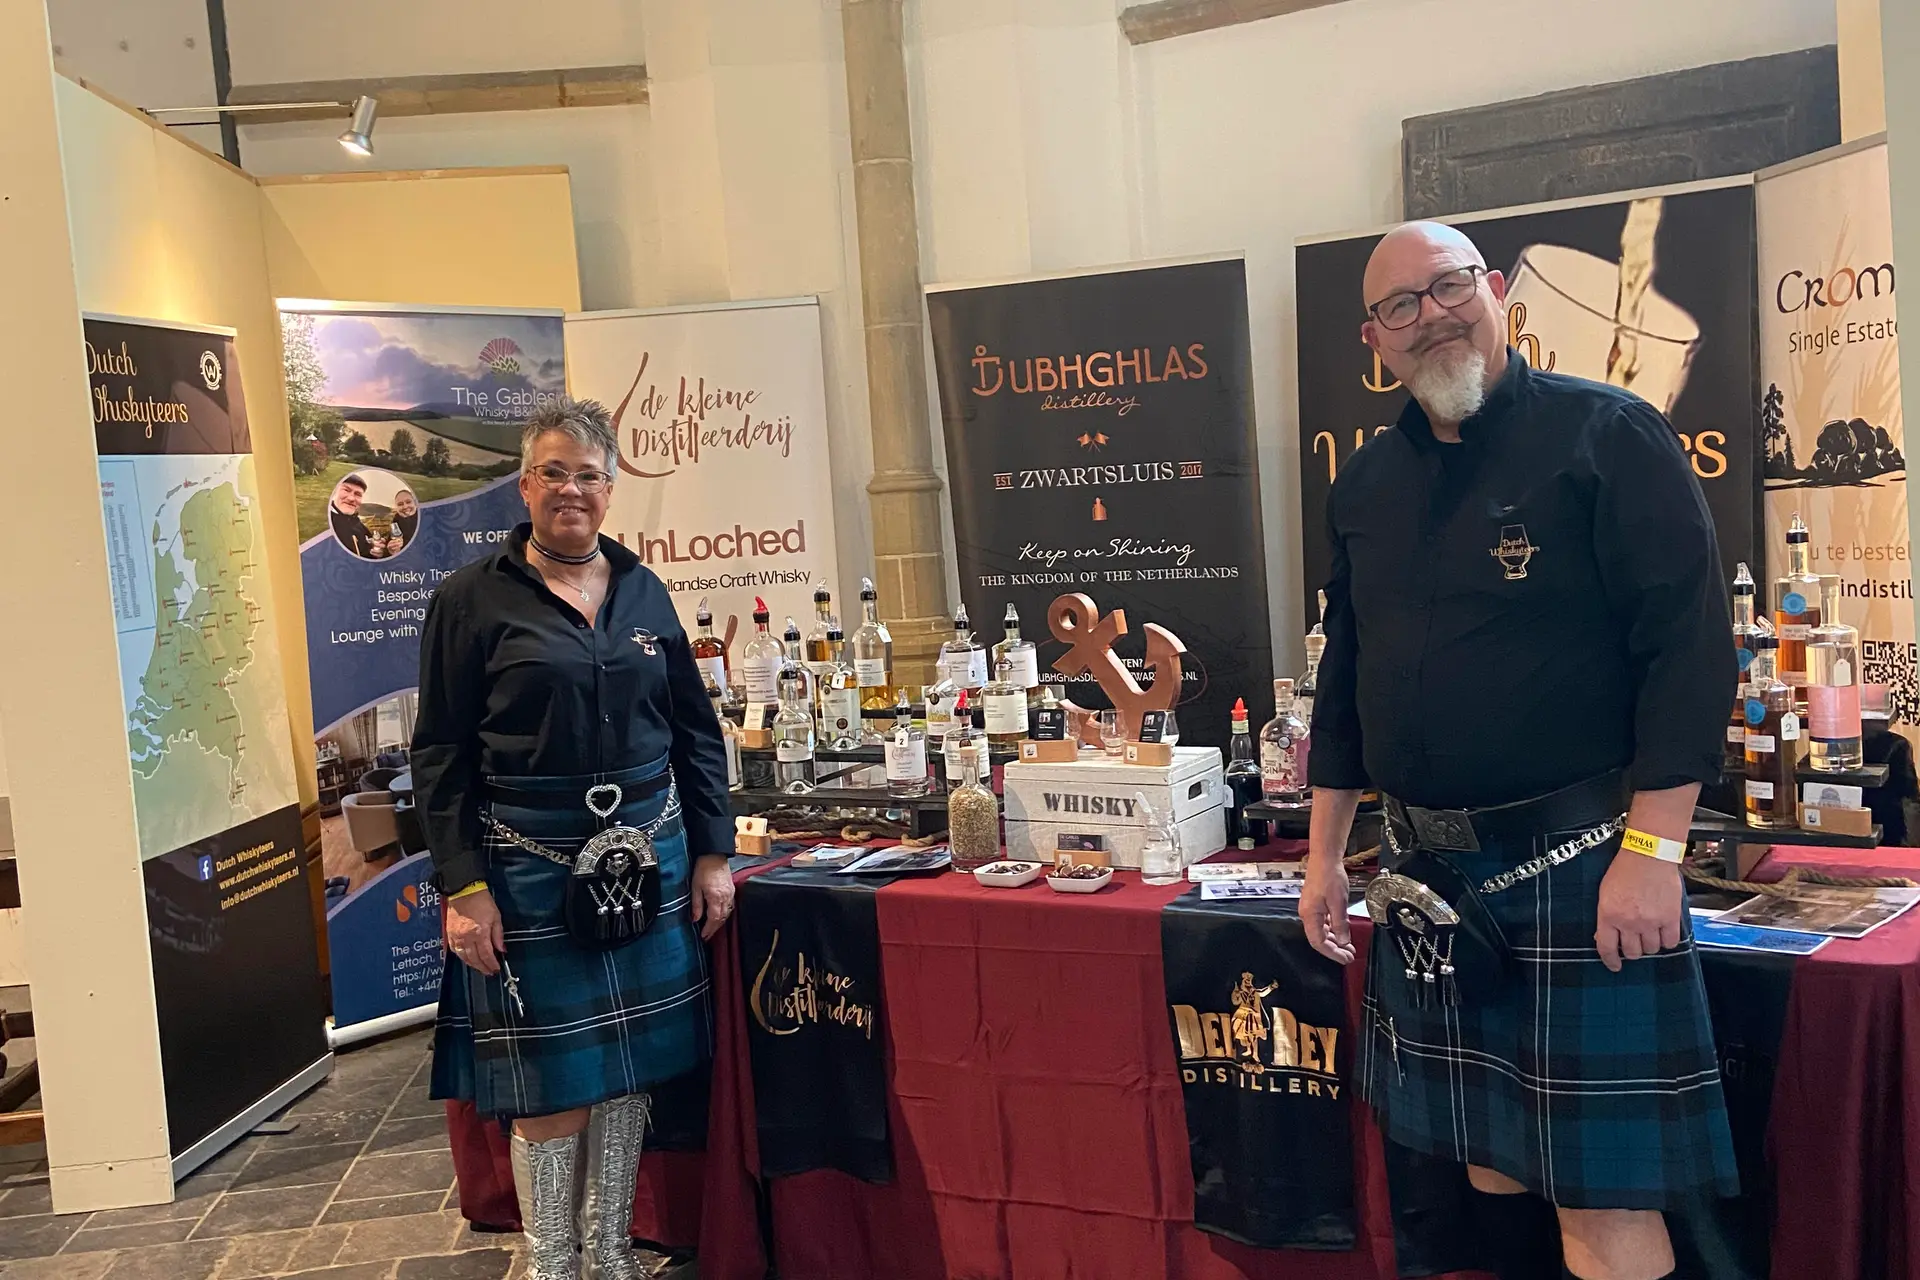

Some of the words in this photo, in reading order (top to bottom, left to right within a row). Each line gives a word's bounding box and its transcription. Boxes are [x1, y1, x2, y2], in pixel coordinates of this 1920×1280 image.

[1789, 325, 1840, 355] Single
[971, 343, 1208, 396] DUBHGHLAS
[450, 387, 489, 406] The
[495, 387, 557, 406] Gables
[641, 385, 668, 420] de
[677, 376, 762, 420] kleine
[1041, 391, 1141, 416] distillery
[473, 406, 511, 419] Whisky
[632, 414, 797, 465] Distilleerderij
[995, 475, 1012, 487] EST
[1019, 461, 1175, 489] ZWARTSLUIS
[1180, 464, 1203, 476] 2017
[463, 531, 483, 545] WE
[486, 530, 511, 543] OFF
[1018, 541, 1068, 567] Keep
[1073, 548, 1103, 558] on
[1106, 538, 1196, 566] Shining
[1827, 543, 1845, 561] te
[379, 571, 426, 585] Whisky
[429, 568, 457, 580] The
[664, 577, 718, 593] llandse
[719, 571, 757, 588] Craft
[760, 568, 811, 585] Whisky
[979, 575, 1006, 587] THE
[1011, 572, 1074, 585] KINGDOM
[1080, 571, 1098, 583] OF
[1104, 570, 1132, 582] THE
[1137, 567, 1239, 581] NETHERLANDS
[371, 607, 426, 622] Evening
[331, 629, 385, 643] Lounge
[388, 624, 418, 638] with
[1785, 723, 1794, 733] 2
[1264, 766, 1279, 774] GIN
[1043, 792, 1138, 817] WHISKY
[216, 855, 236, 872] Dutch
[236, 841, 275, 863] Whiskyteers
[219, 848, 296, 890] www.dutchwhiskyteers.nl
[221, 866, 299, 911] info@dutchwhiskyteers.nl
[391, 945, 410, 957] The
[1172, 1004, 1237, 1060] DEL
[1271, 1007, 1338, 1075] REY
